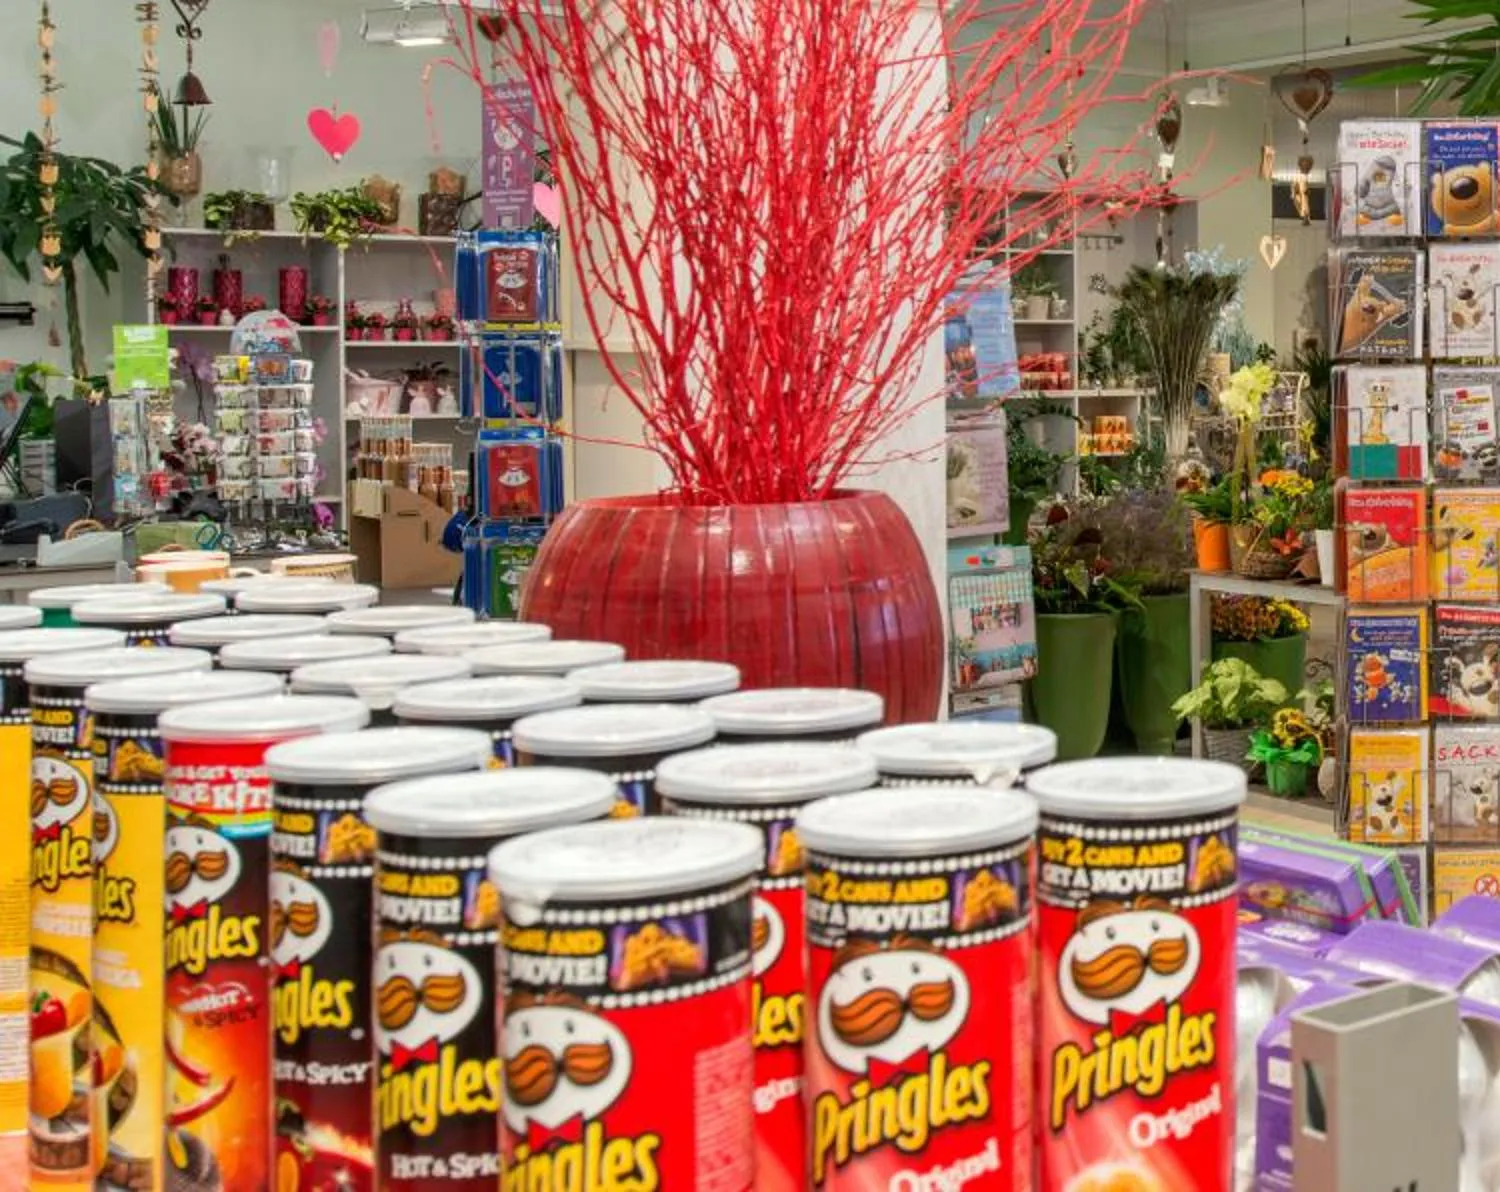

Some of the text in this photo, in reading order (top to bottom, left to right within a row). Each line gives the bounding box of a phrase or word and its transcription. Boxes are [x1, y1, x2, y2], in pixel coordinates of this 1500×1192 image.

[32, 826, 92, 892] ngle
[1065, 836, 1084, 866] 2
[1085, 845, 1135, 867] CANS
[1135, 841, 1185, 867] AND
[410, 873, 460, 897] AND
[821, 871, 948, 903] 2 CANS AND
[1043, 862, 1187, 894] GET A MOVIE!
[379, 895, 462, 924] MOVIE!
[829, 902, 847, 927] A
[846, 899, 949, 932] MOVIE!
[163, 904, 260, 975] ingles
[547, 928, 605, 955] AND
[509, 951, 608, 986] MOVIE!
[275, 964, 355, 1046] gles
[307, 1060, 370, 1086] SPICY
[1051, 1001, 1217, 1134] Pringles
[378, 1044, 502, 1137] ingles
[813, 1050, 992, 1188] Pringles
[1129, 1082, 1222, 1149] Original
[391, 1152, 432, 1178] HOT
[449, 1151, 500, 1178] SPIC
[502, 1120, 661, 1192] ingles
